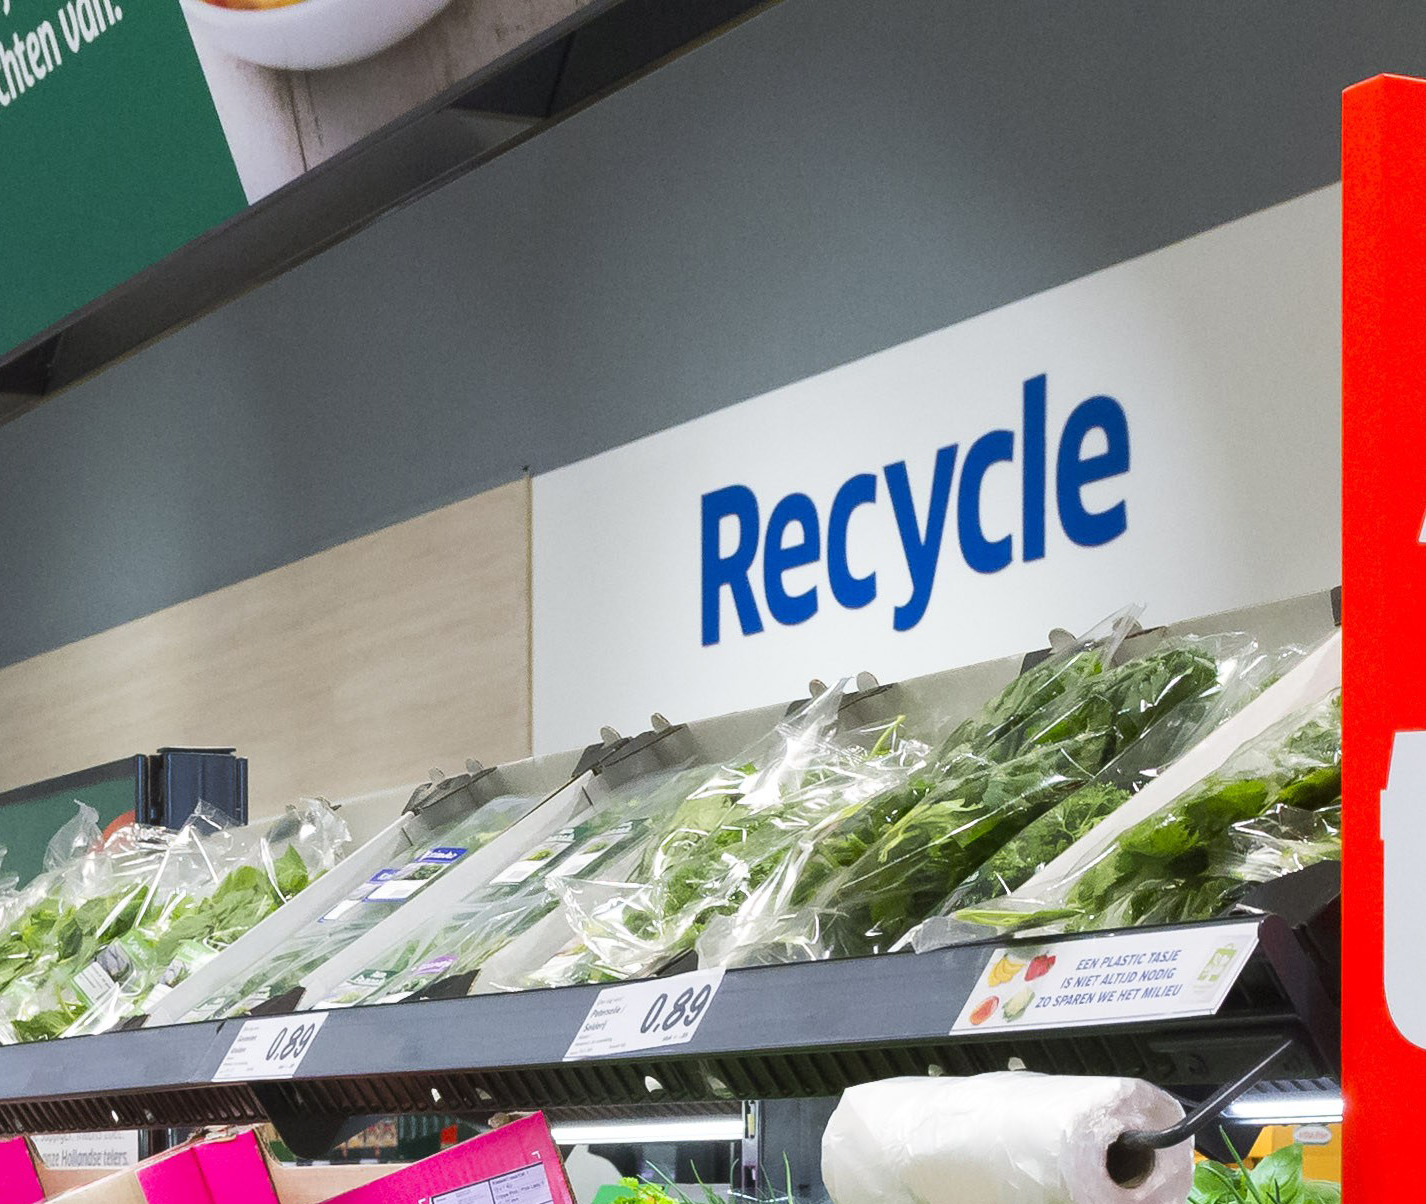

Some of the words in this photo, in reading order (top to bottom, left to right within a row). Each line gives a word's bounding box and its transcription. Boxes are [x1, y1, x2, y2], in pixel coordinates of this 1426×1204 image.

[700, 373, 1131, 647] Recycle
[1076, 958, 1098, 971] EEN
[1100, 954, 1147, 968] PLASTIC
[1147, 950, 1182, 963] TASJE
[1060, 978, 1070, 989] IS
[1073, 975, 1099, 988] NIET
[1102, 970, 1137, 985] ALTIJD
[1139, 968, 1176, 982] NODIG
[640, 984, 712, 1034] 0.89
[1035, 997, 1051, 1008] ZO
[1052, 992, 1095, 1007] SPAREN
[1097, 990, 1114, 1003] WE
[1117, 988, 1141, 1002] HET
[1142, 984, 1184, 998] MILIEU
[265, 1023, 316, 1061] 0.89
